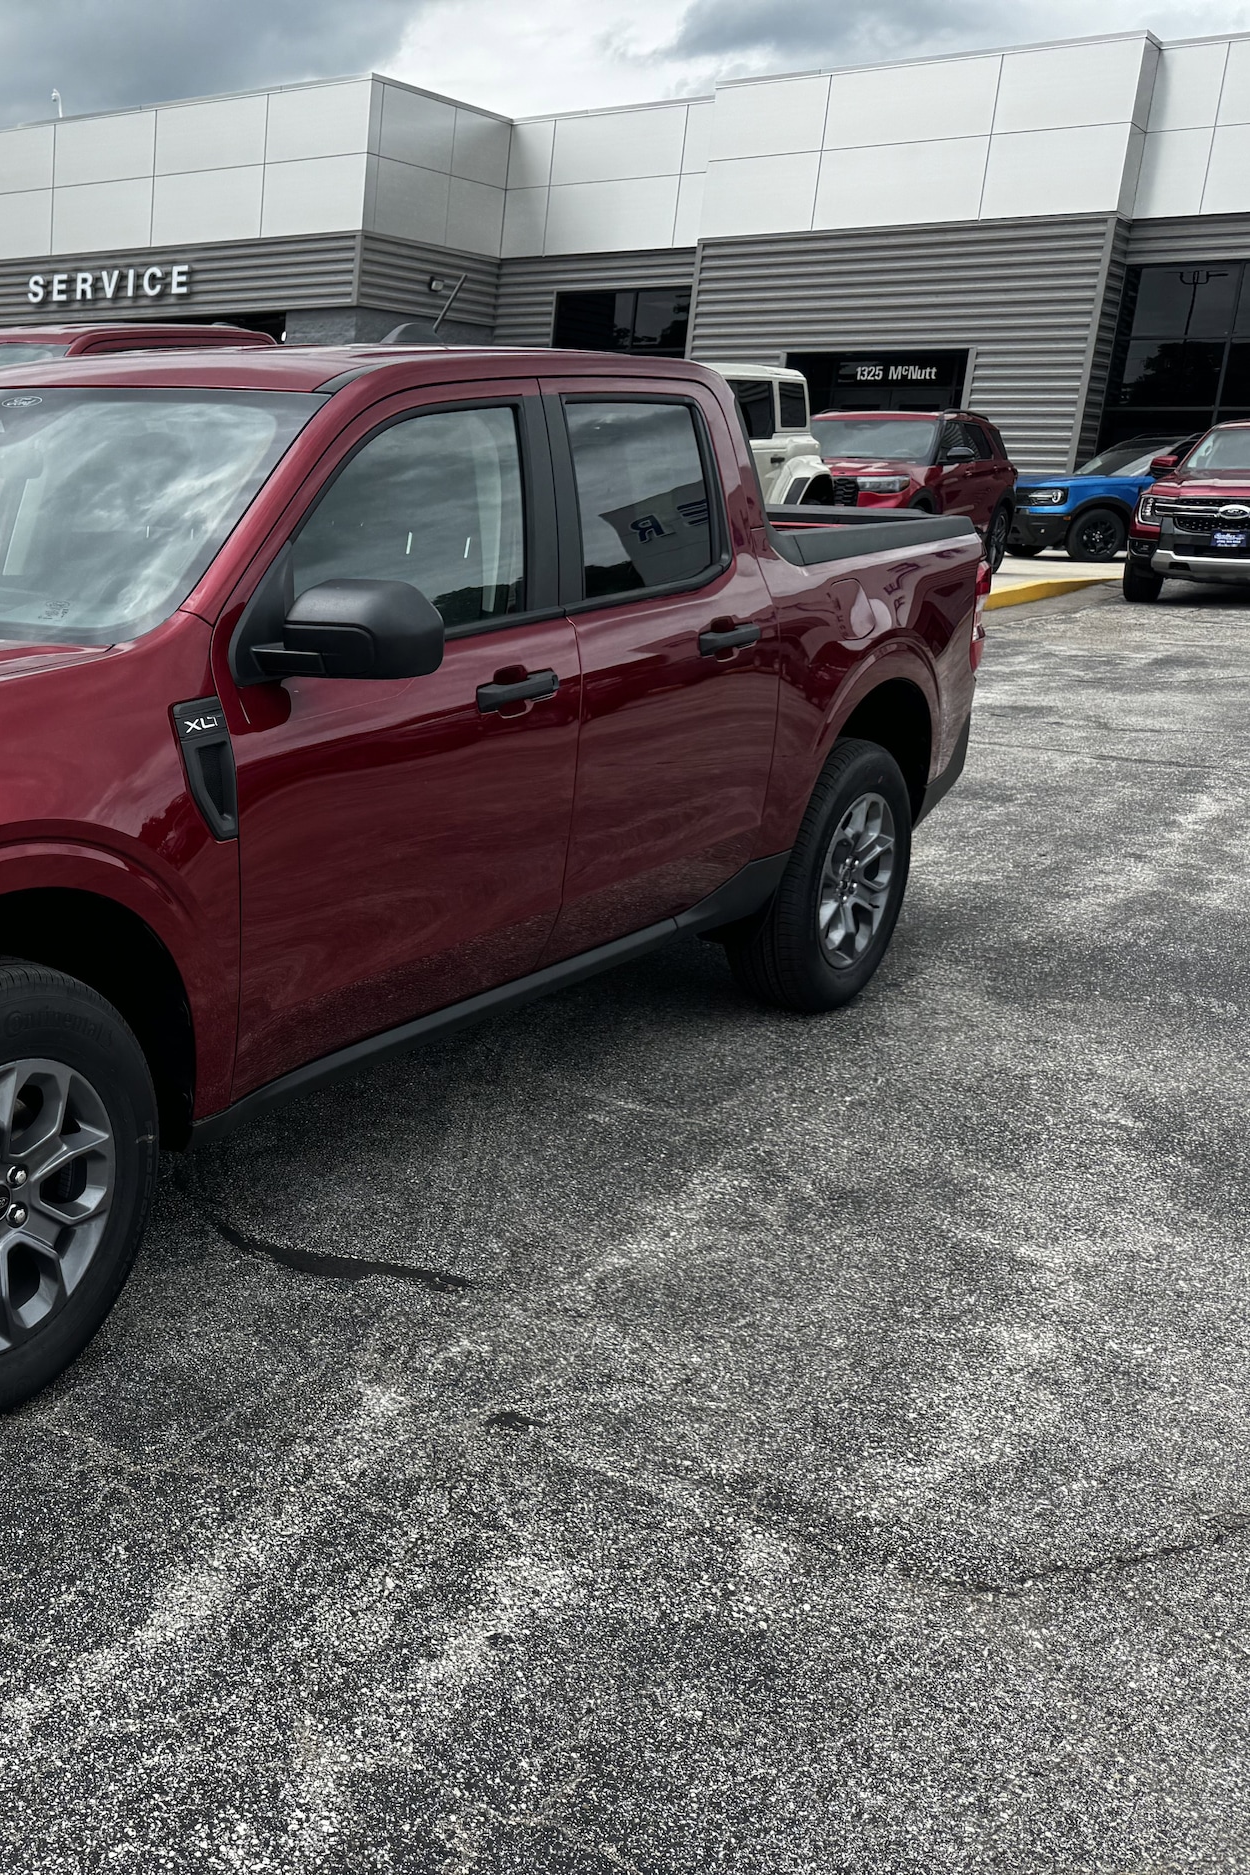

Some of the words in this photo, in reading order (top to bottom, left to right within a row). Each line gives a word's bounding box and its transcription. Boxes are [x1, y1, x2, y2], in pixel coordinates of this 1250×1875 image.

[27, 264, 190, 304] SERVICE
[855, 365, 884, 381] 1325
[888, 365, 937, 380] McNutt
[183, 716, 218, 733] XLT
